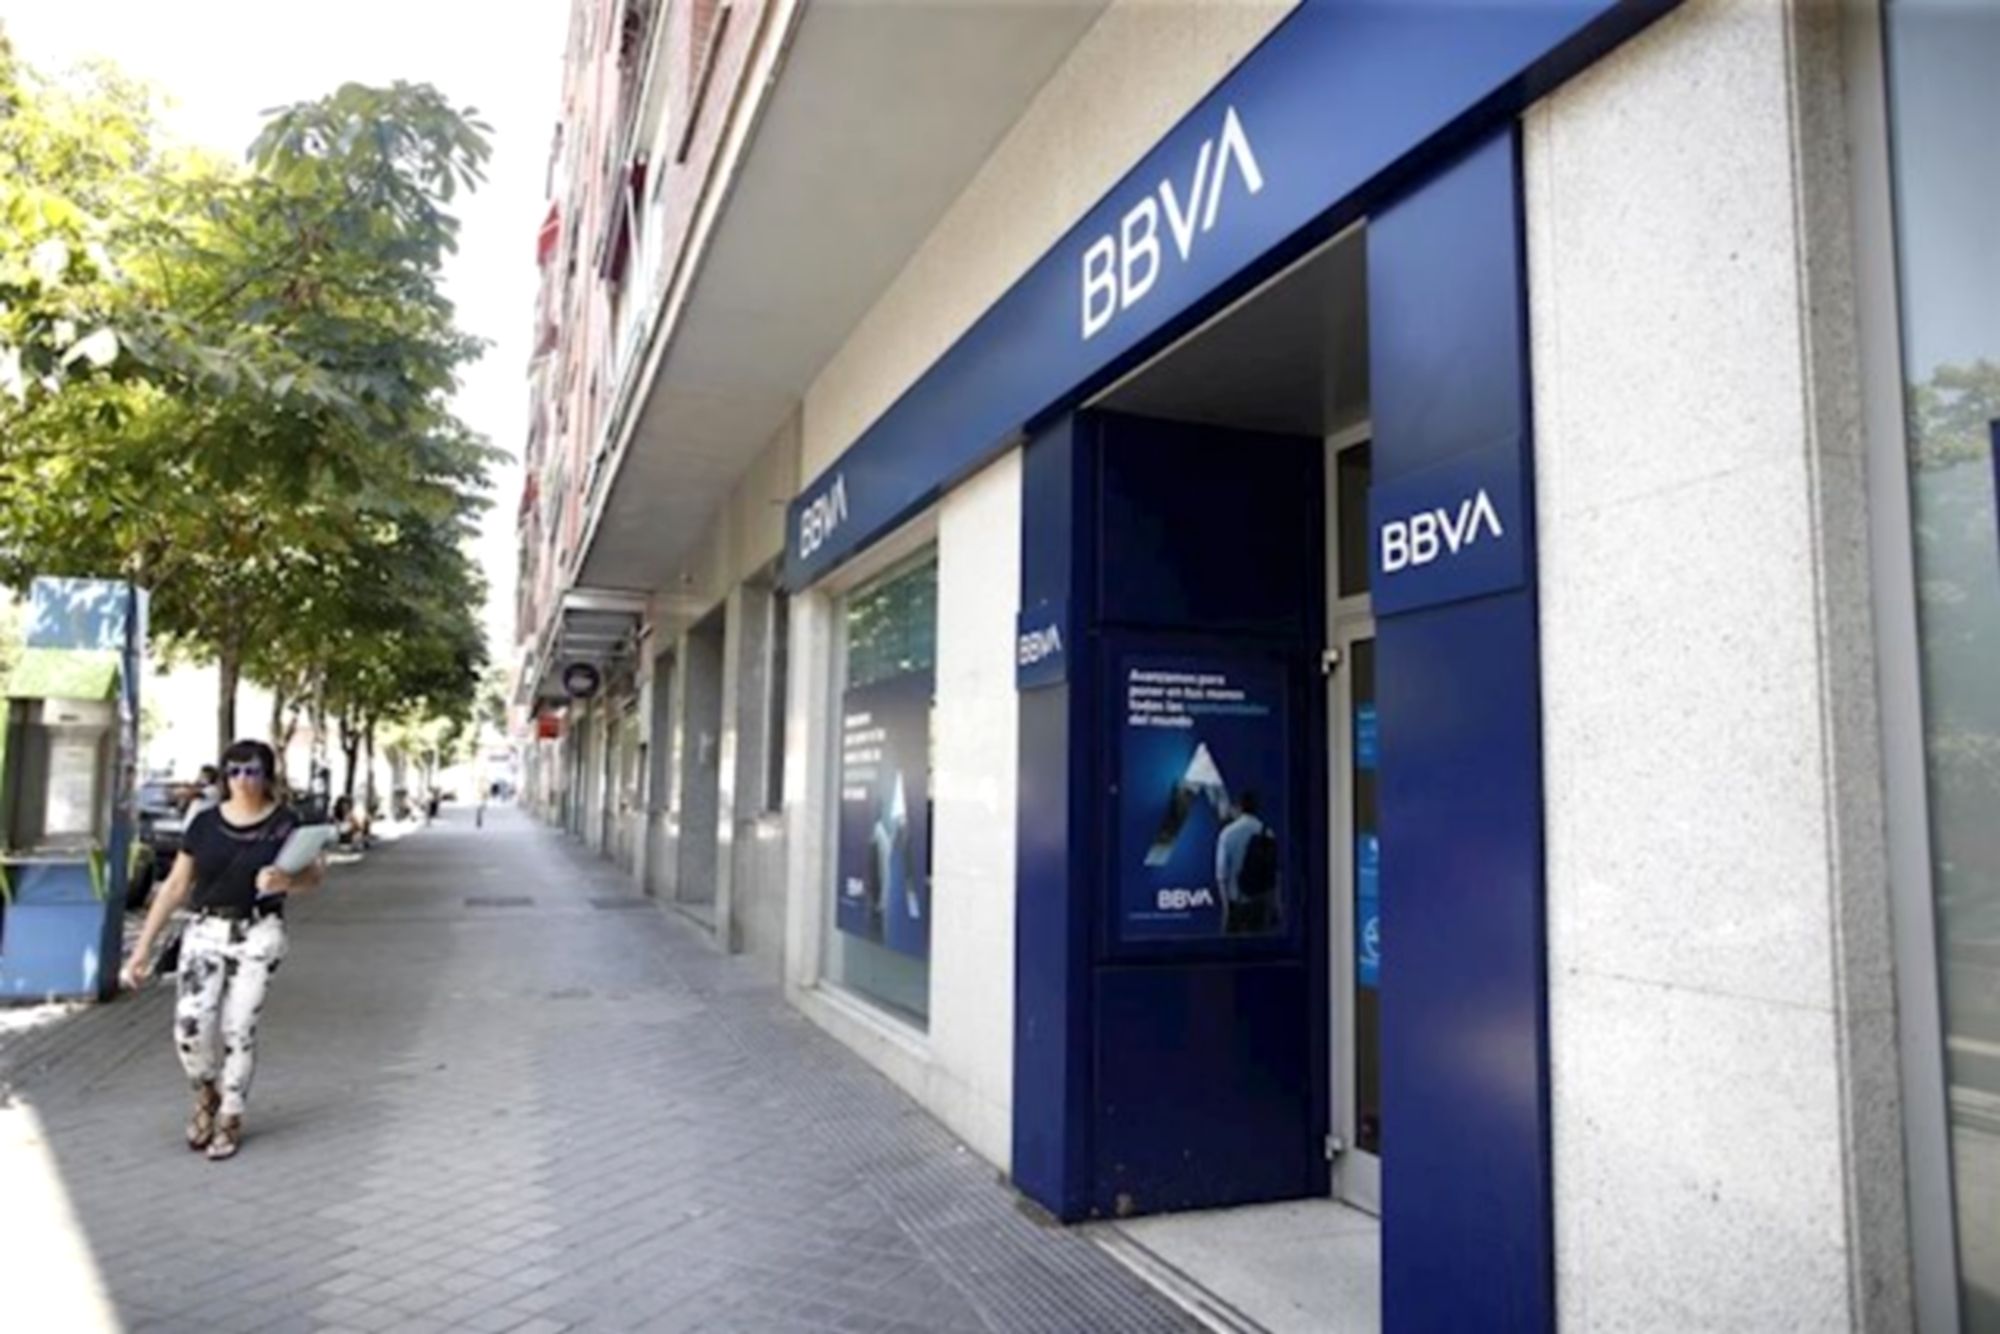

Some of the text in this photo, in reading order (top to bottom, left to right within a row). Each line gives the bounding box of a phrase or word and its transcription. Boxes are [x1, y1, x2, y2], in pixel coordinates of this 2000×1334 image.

[1082, 105, 1264, 341] BBVA
[800, 473, 848, 559] BBVA
[1381, 488, 1503, 573] BBVA
[1017, 624, 1061, 665] BBVA
[1158, 888, 1214, 909] BBVA
